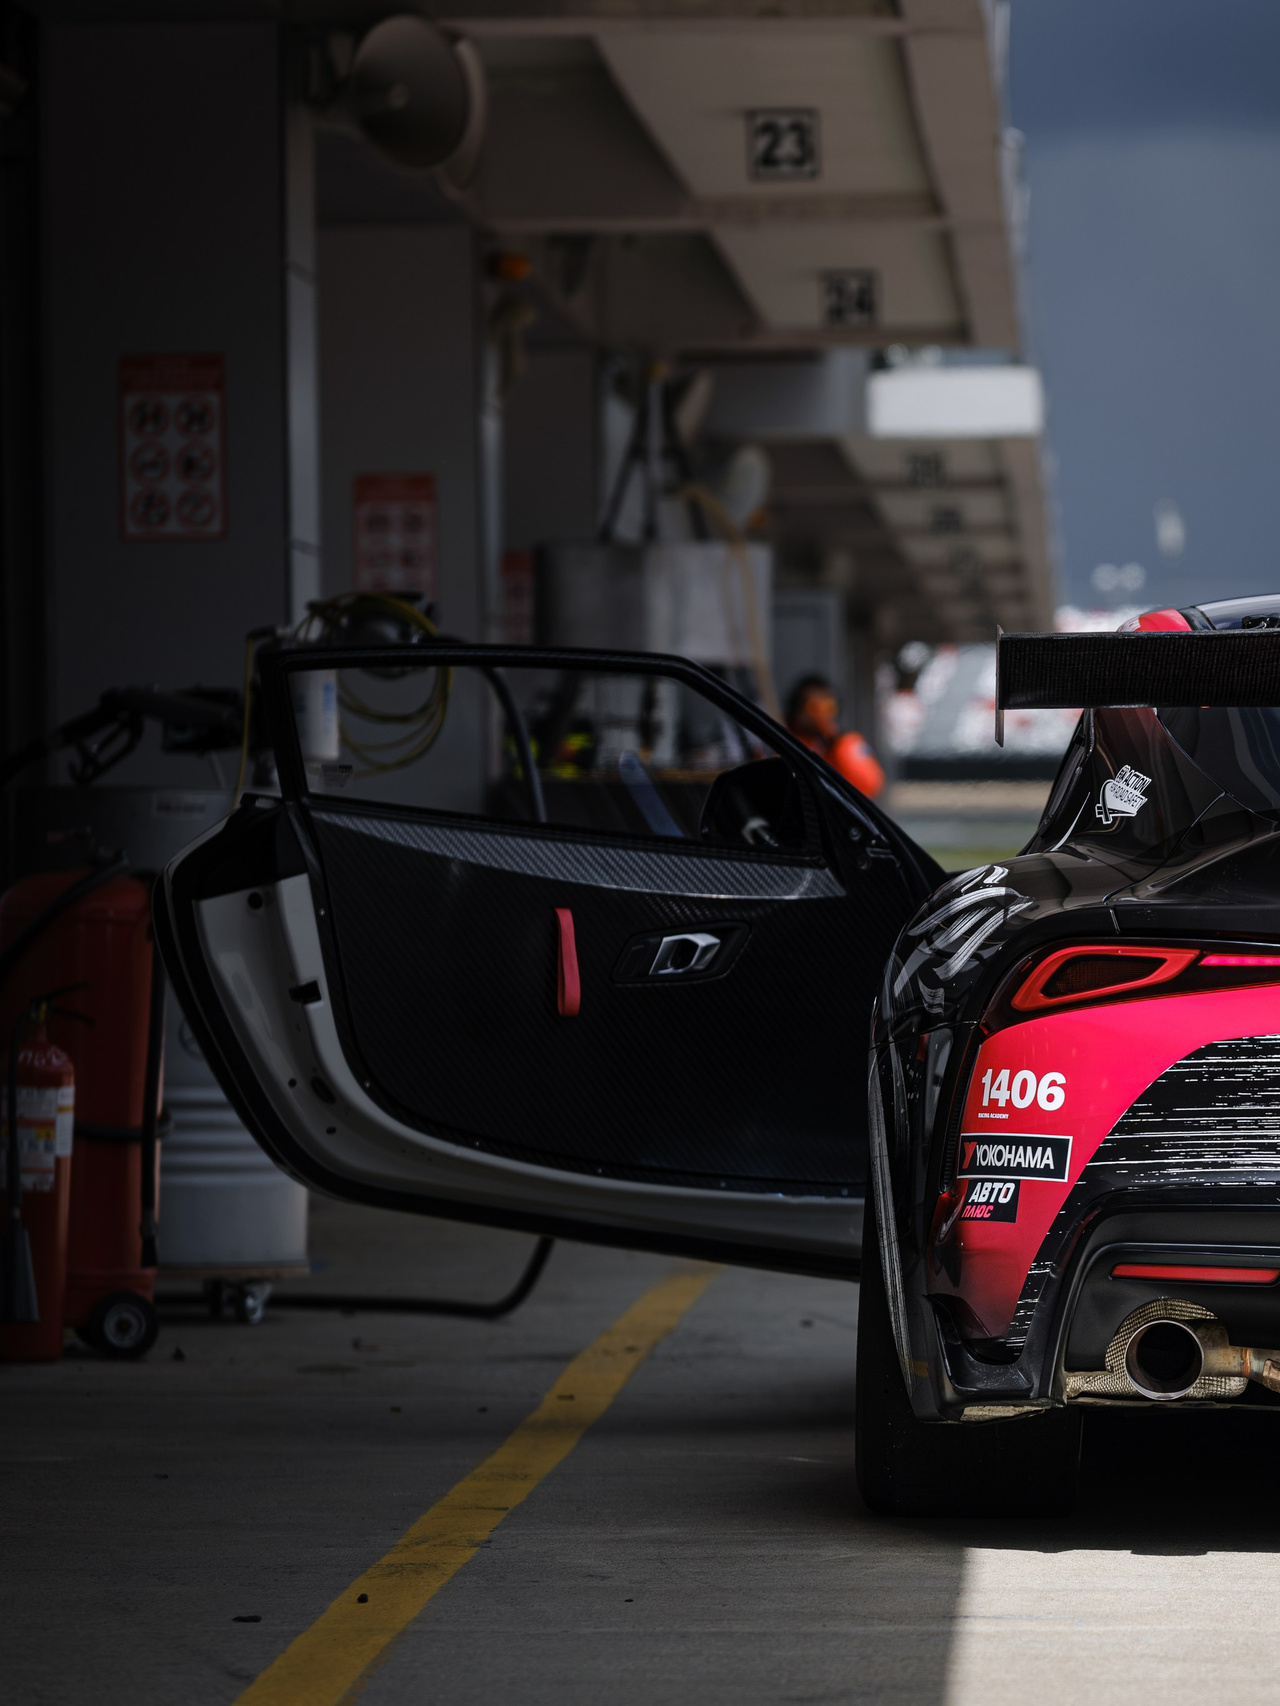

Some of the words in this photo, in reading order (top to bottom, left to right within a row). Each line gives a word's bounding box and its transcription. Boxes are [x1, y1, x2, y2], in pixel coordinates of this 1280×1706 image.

[754, 120, 814, 168] 23
[981, 1068, 1067, 1111] 1406
[976, 1144, 1055, 1170] YOKOHAMA
[968, 1181, 1016, 1204] АВТО
[961, 1204, 994, 1219] ПЛЮС
